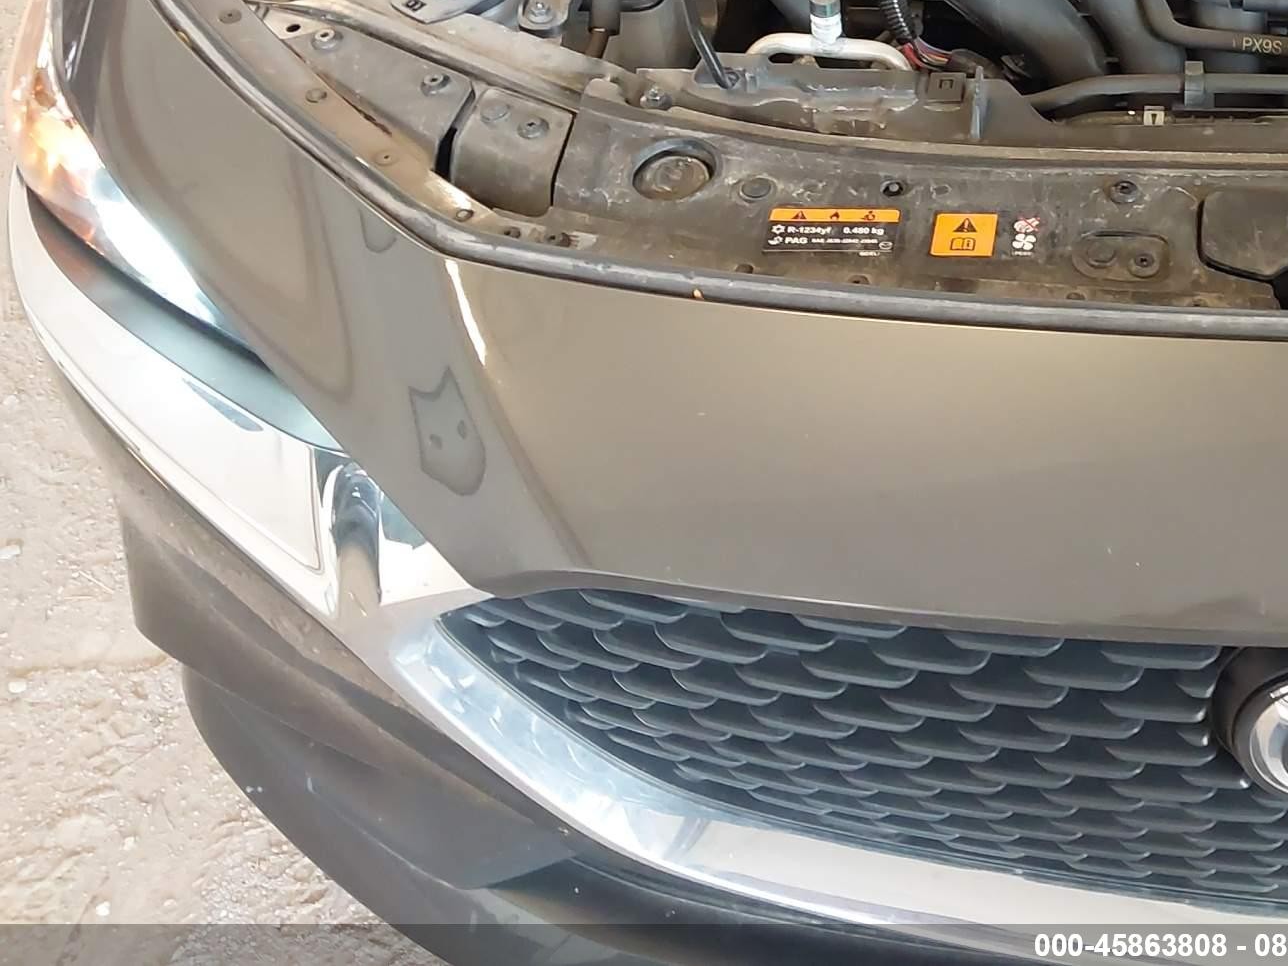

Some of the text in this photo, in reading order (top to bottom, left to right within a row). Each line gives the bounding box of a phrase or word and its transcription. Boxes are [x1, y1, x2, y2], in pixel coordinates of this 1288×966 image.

[1242, 36, 1282, 55] PX9S
[787, 225, 832, 235] R-1234yf
[871, 226, 885, 236] kg
[785, 236, 808, 244] PAG
